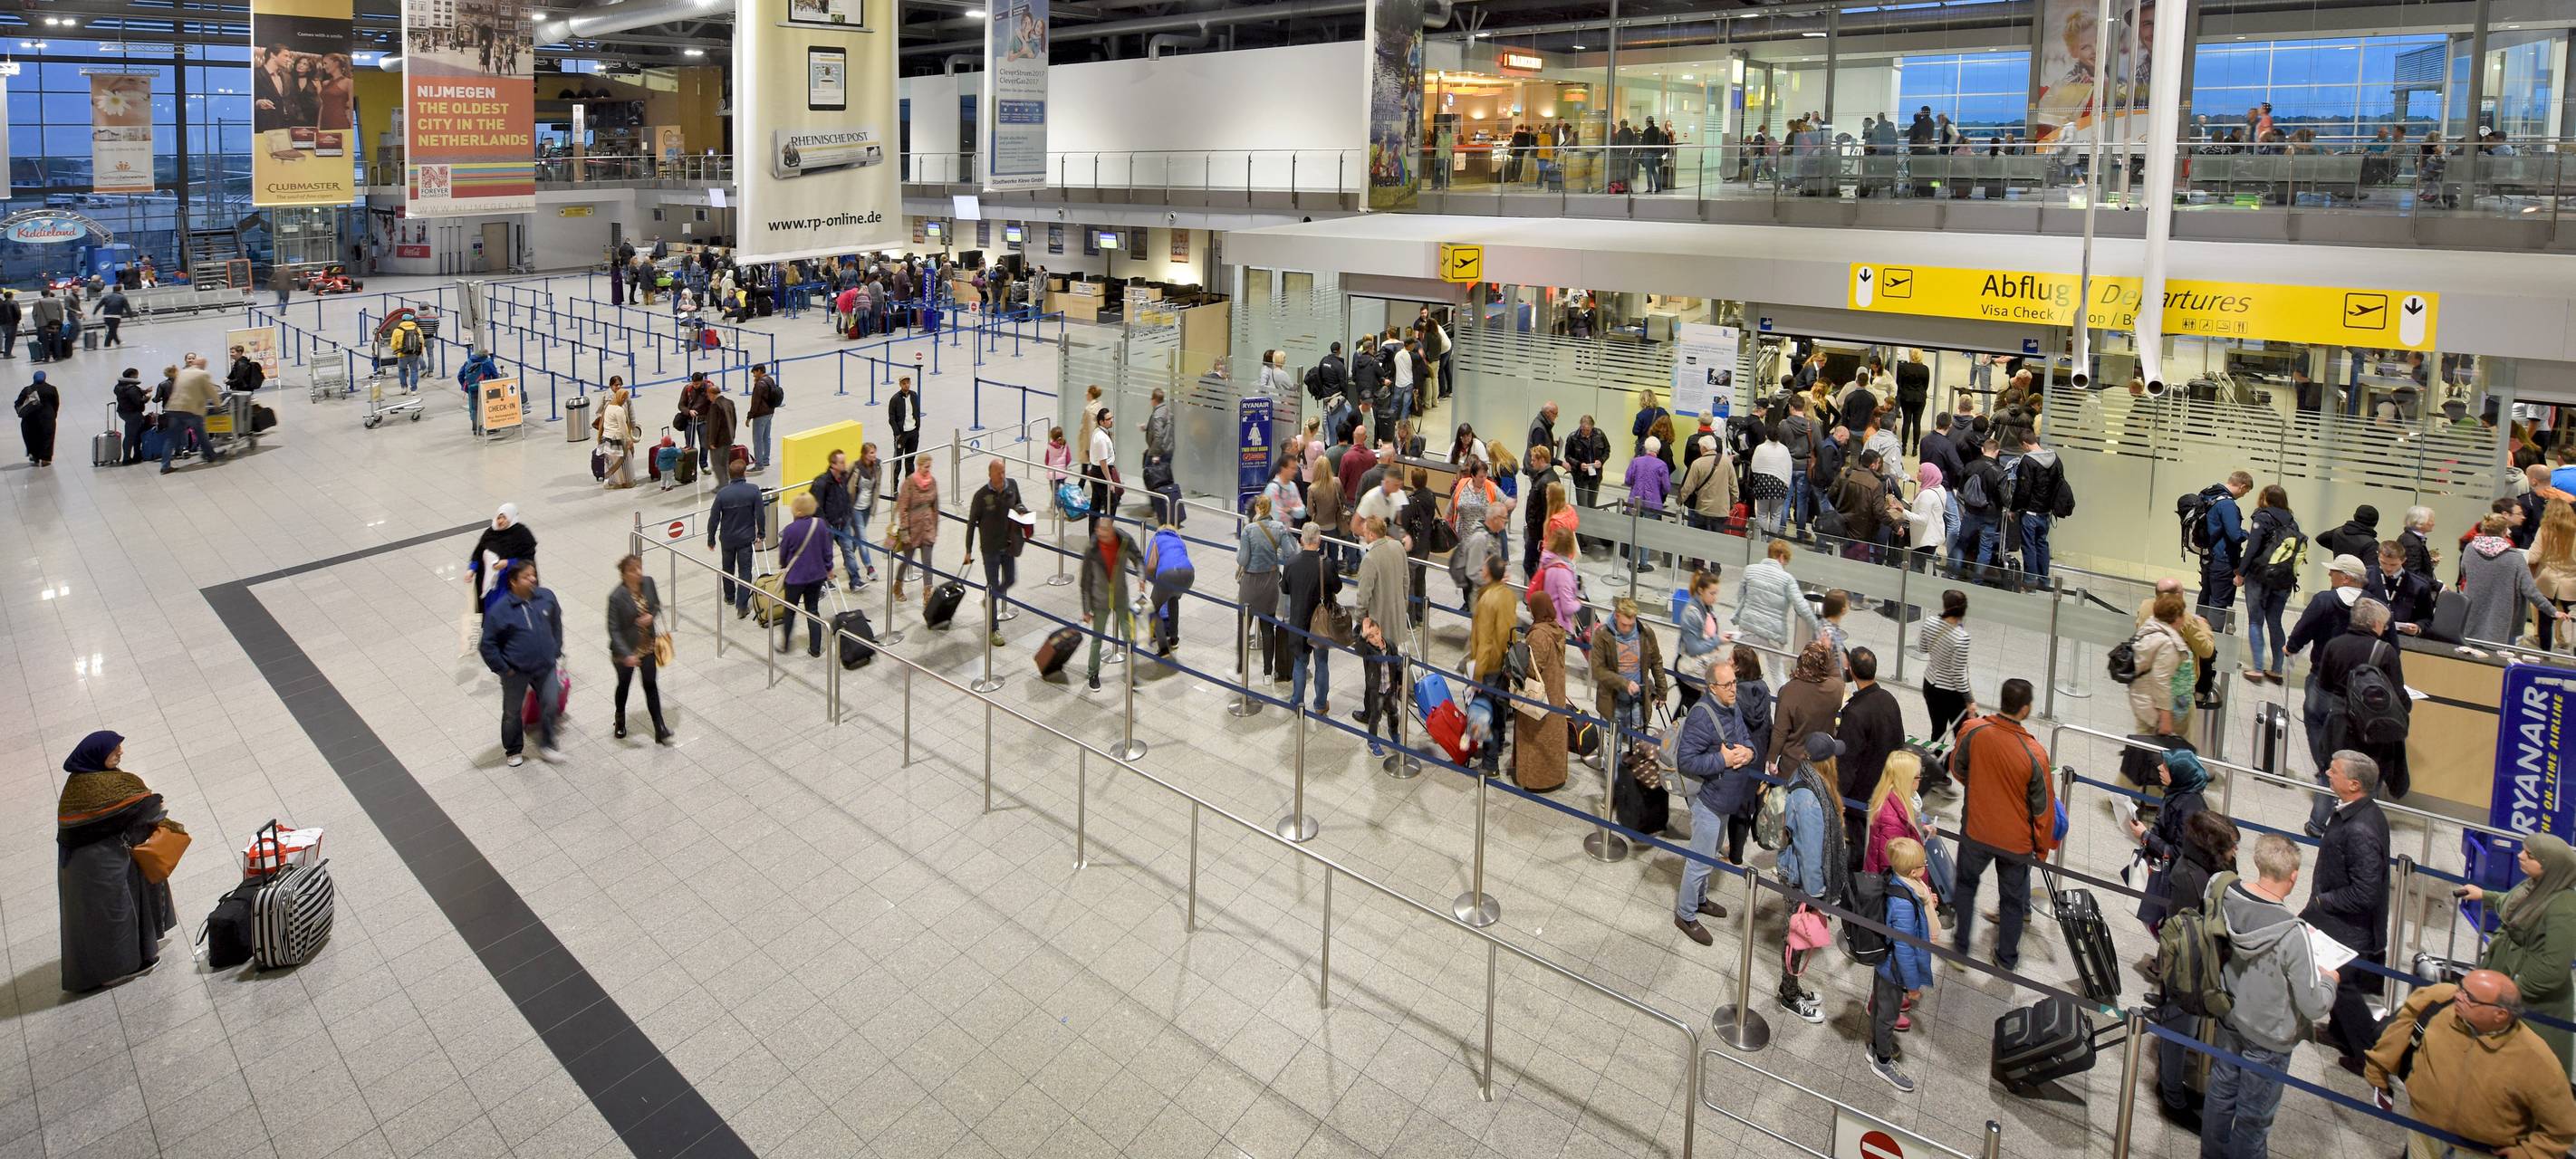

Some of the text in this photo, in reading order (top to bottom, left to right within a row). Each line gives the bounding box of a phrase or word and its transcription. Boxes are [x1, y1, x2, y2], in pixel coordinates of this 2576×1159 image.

[417, 85, 495, 99] NIJMEGEN
[417, 101, 509, 114] THE OLDEST
[418, 118, 505, 130] CITY IN THE
[418, 134, 528, 147] NETHERLANDS
[791, 131, 870, 146] RHEINISCHE POST
[265, 182, 342, 193] CLUBMASTER
[768, 210, 882, 232] www.rp-online.de
[16, 225, 77, 238] Kiddieland
[1981, 274, 2071, 307] Abflug
[1981, 304, 2008, 317] Visa
[2014, 306, 2054, 320] Check
[488, 403, 515, 412] CHECK-IN
[2549, 694, 2564, 750] AIRLINE
[2511, 685, 2550, 838] RYANAIR
[2543, 751, 2558, 810] ON-TIME
